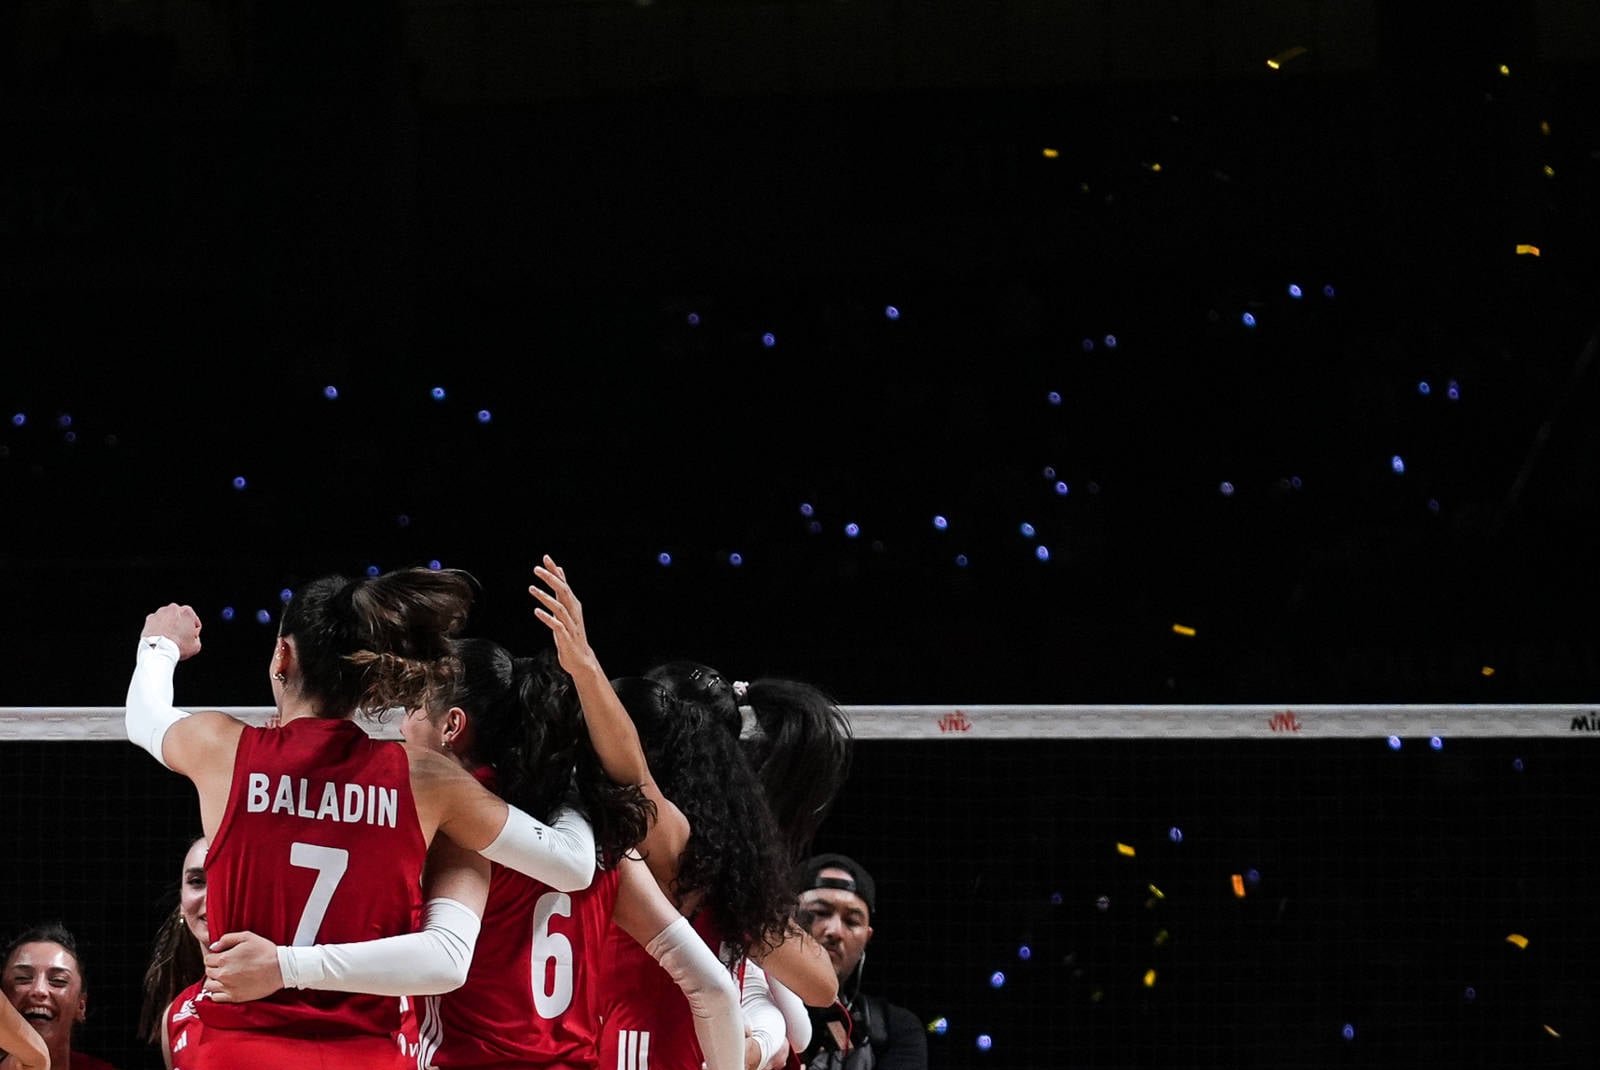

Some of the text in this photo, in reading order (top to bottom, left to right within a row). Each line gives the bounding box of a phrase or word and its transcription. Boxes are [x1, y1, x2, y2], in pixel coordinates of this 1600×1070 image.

[247, 772, 398, 828] BALADIN
[290, 842, 349, 946] 7
[531, 891, 573, 1019] 6
